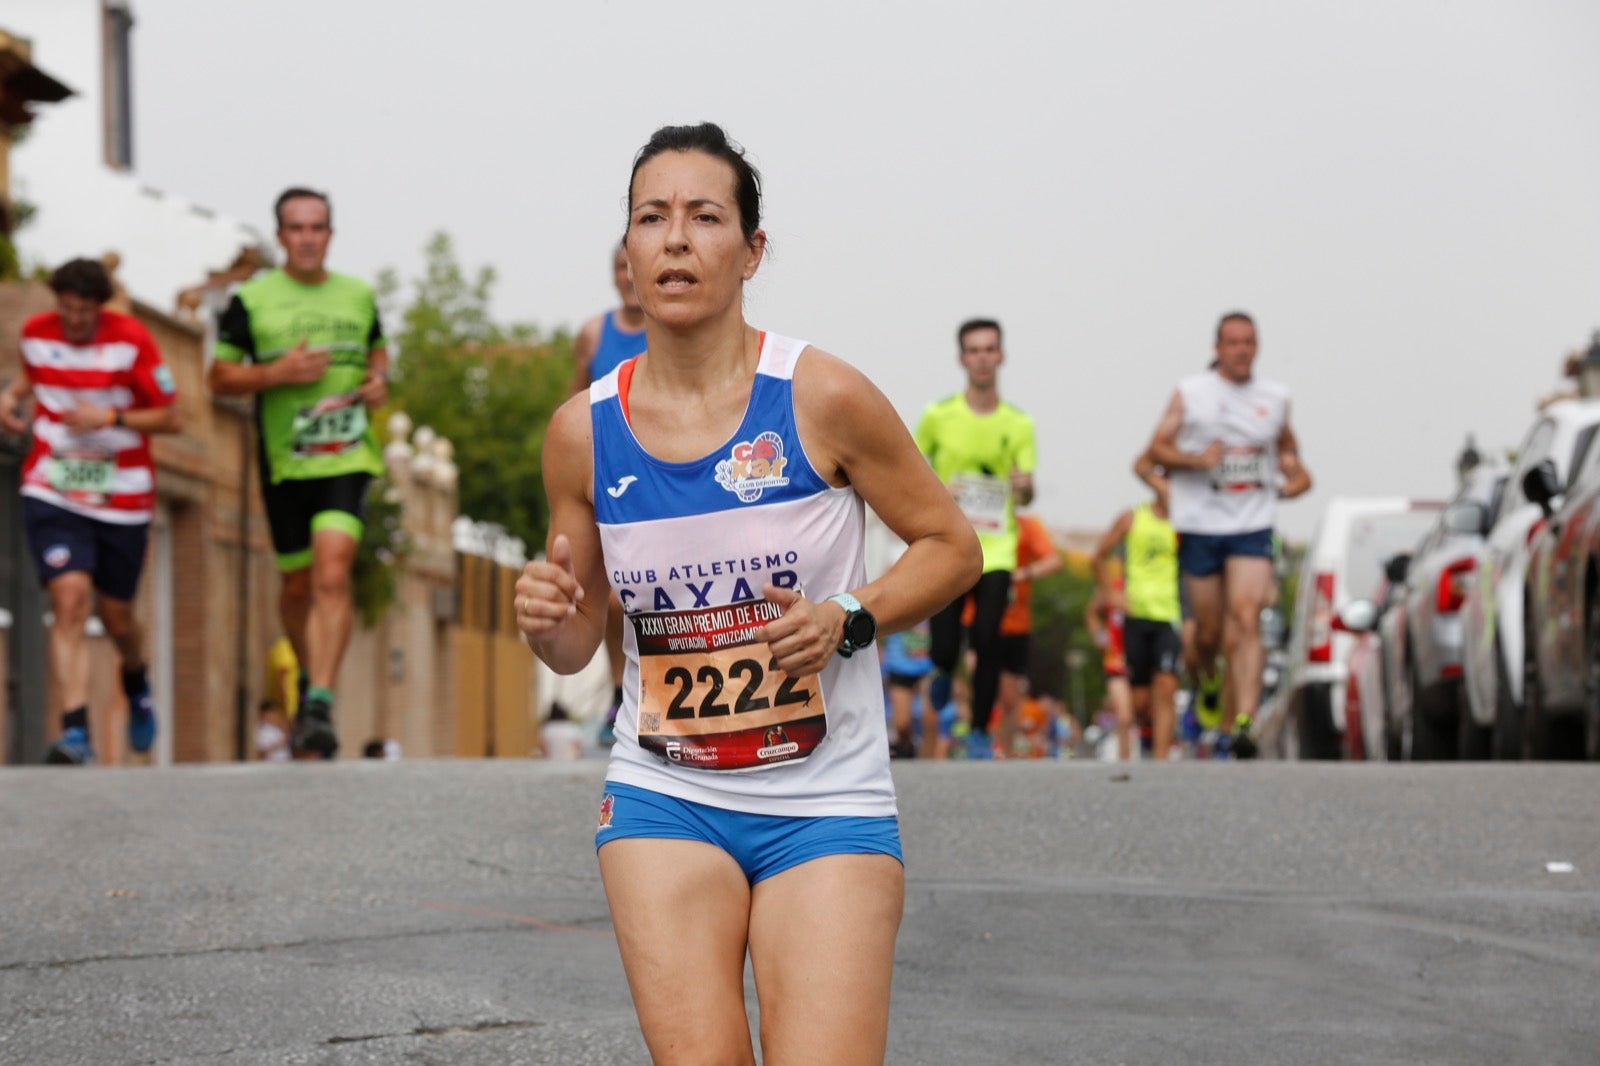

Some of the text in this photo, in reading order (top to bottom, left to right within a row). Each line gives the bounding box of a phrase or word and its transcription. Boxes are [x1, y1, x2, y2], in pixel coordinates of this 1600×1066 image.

[613, 551, 798, 584] CLUB ATLETISMO
[639, 616, 665, 636] XXXII
[665, 614, 694, 634] GRAN
[693, 609, 734, 633] PREMIO
[737, 606, 753, 625] DE
[664, 658, 810, 720] 2222
[691, 753, 718, 761] Granada
[760, 744, 796, 757] Cruzcampo
